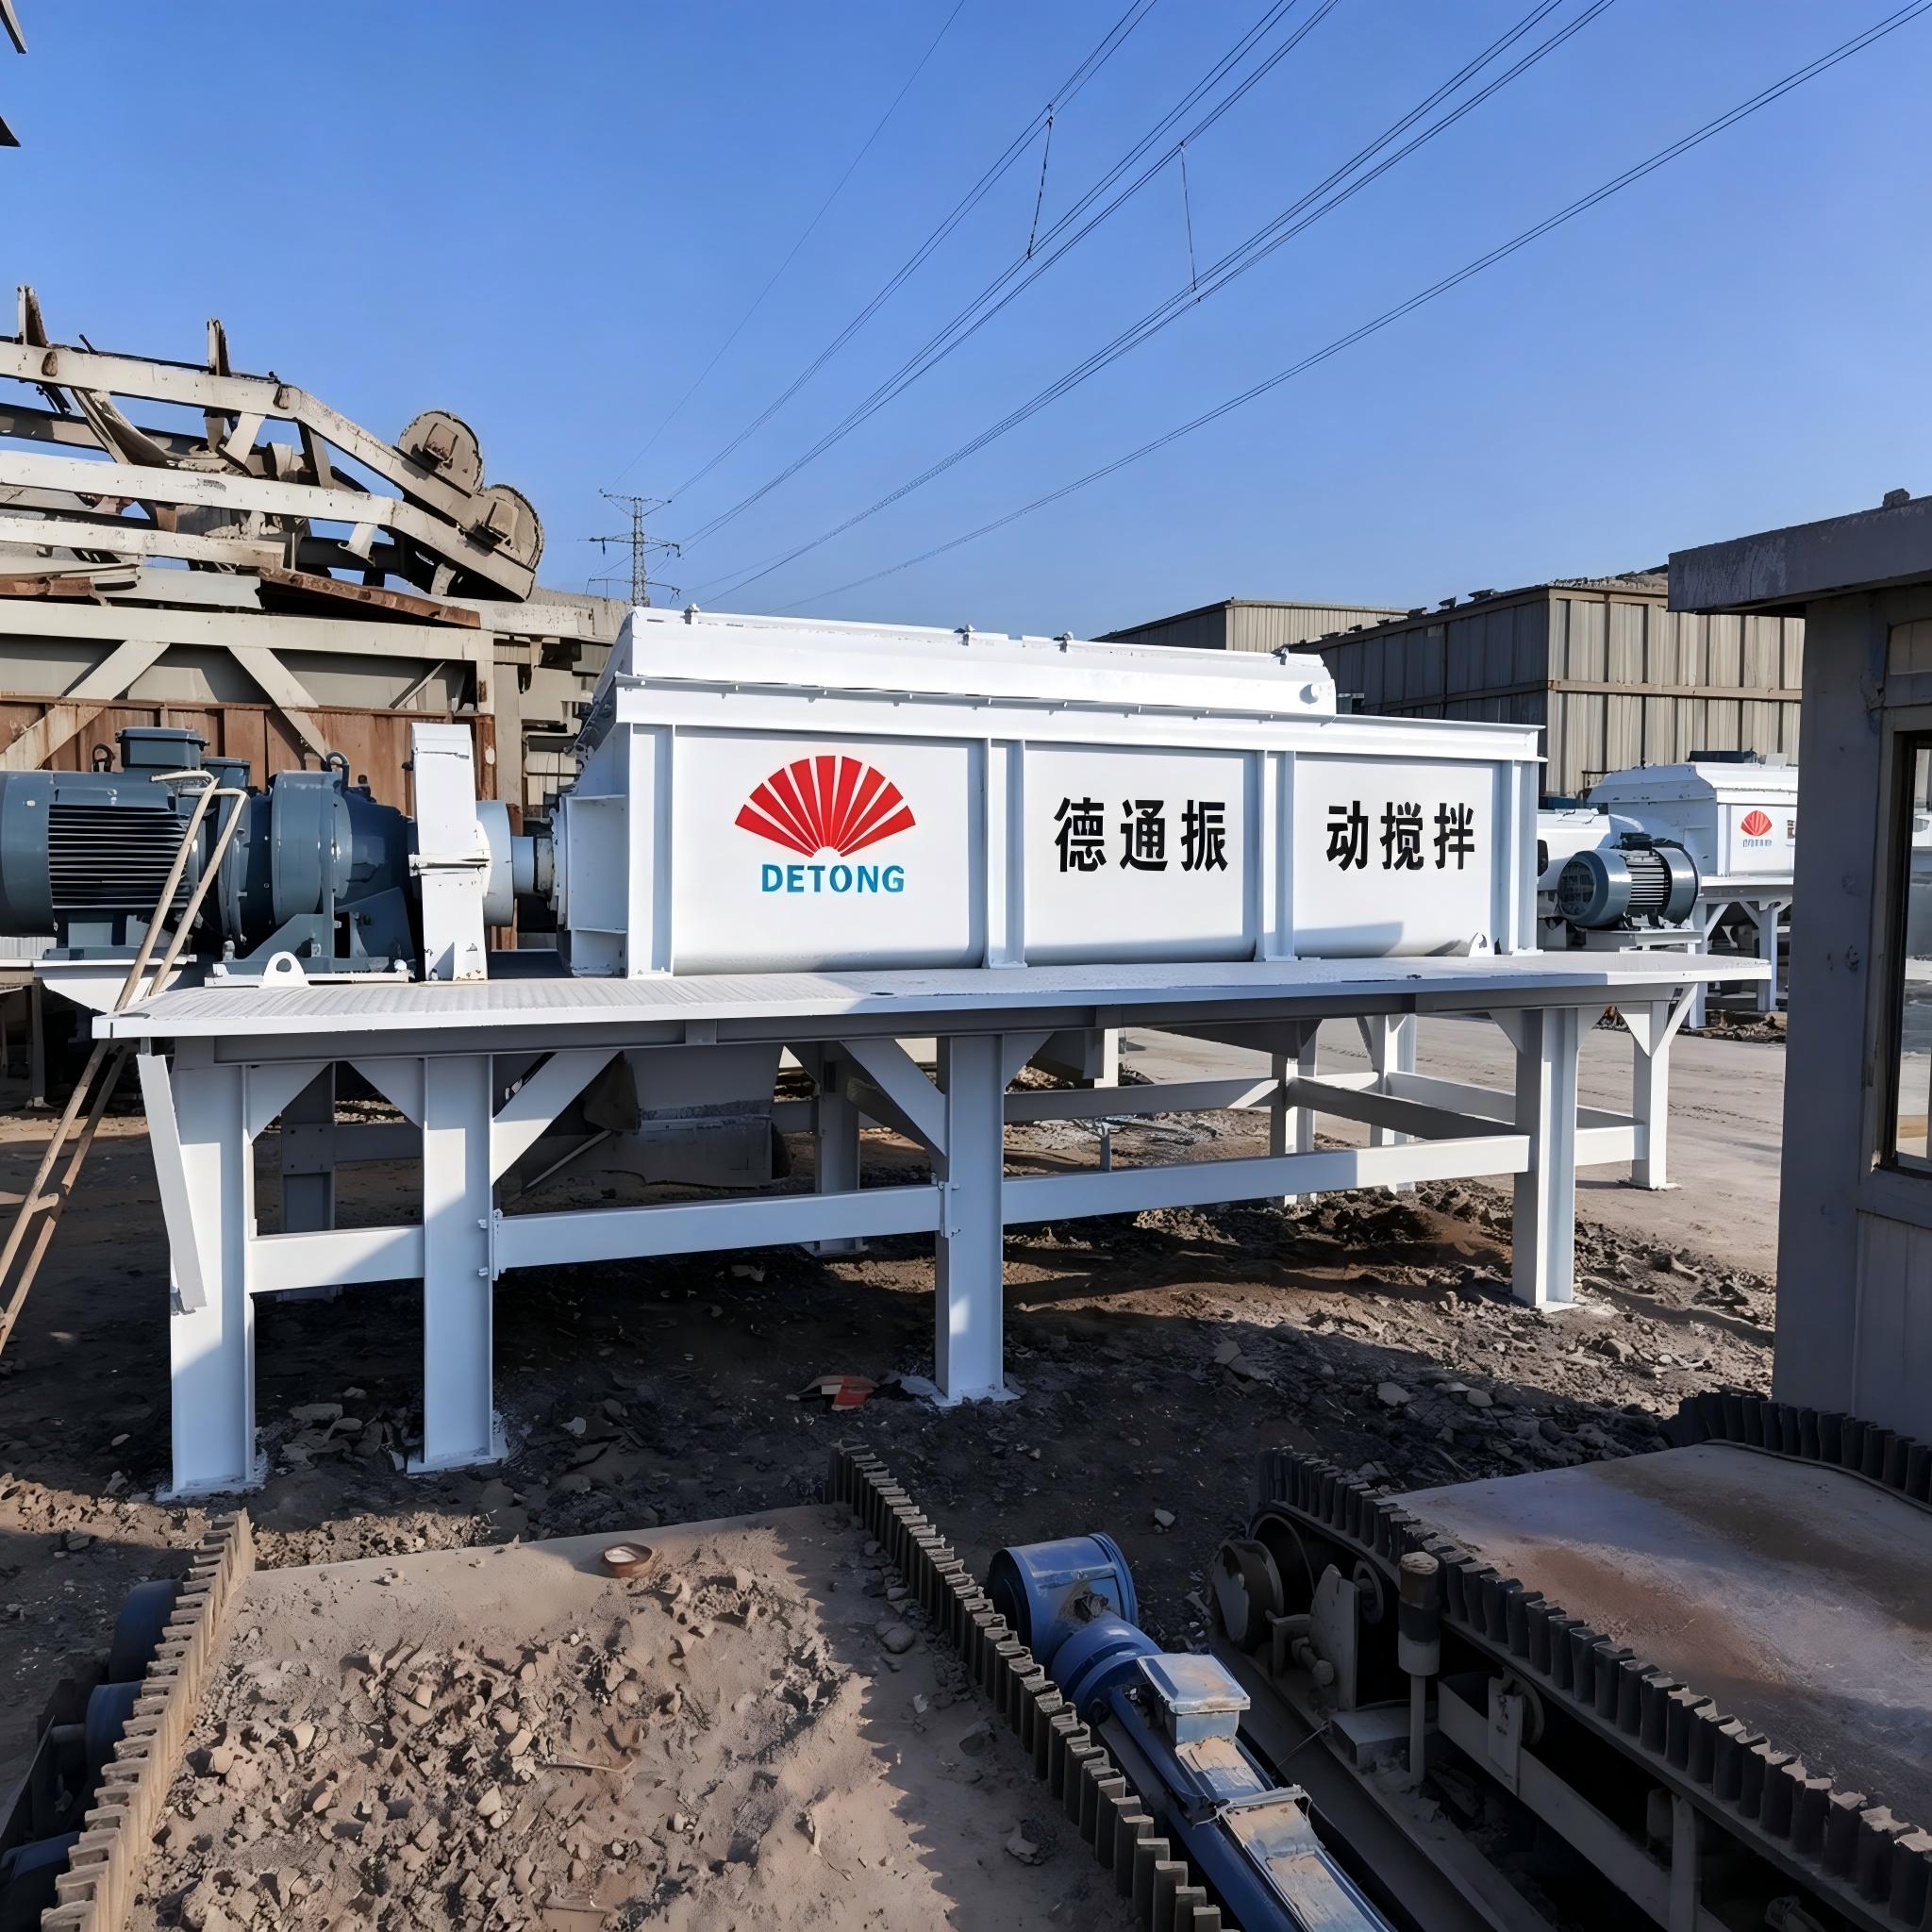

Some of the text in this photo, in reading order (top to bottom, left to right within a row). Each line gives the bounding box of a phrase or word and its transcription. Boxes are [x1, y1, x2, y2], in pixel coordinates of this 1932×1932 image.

[1054, 797, 1475, 873] 德通振 动搅拌
[762, 864, 904, 892] DETONG
